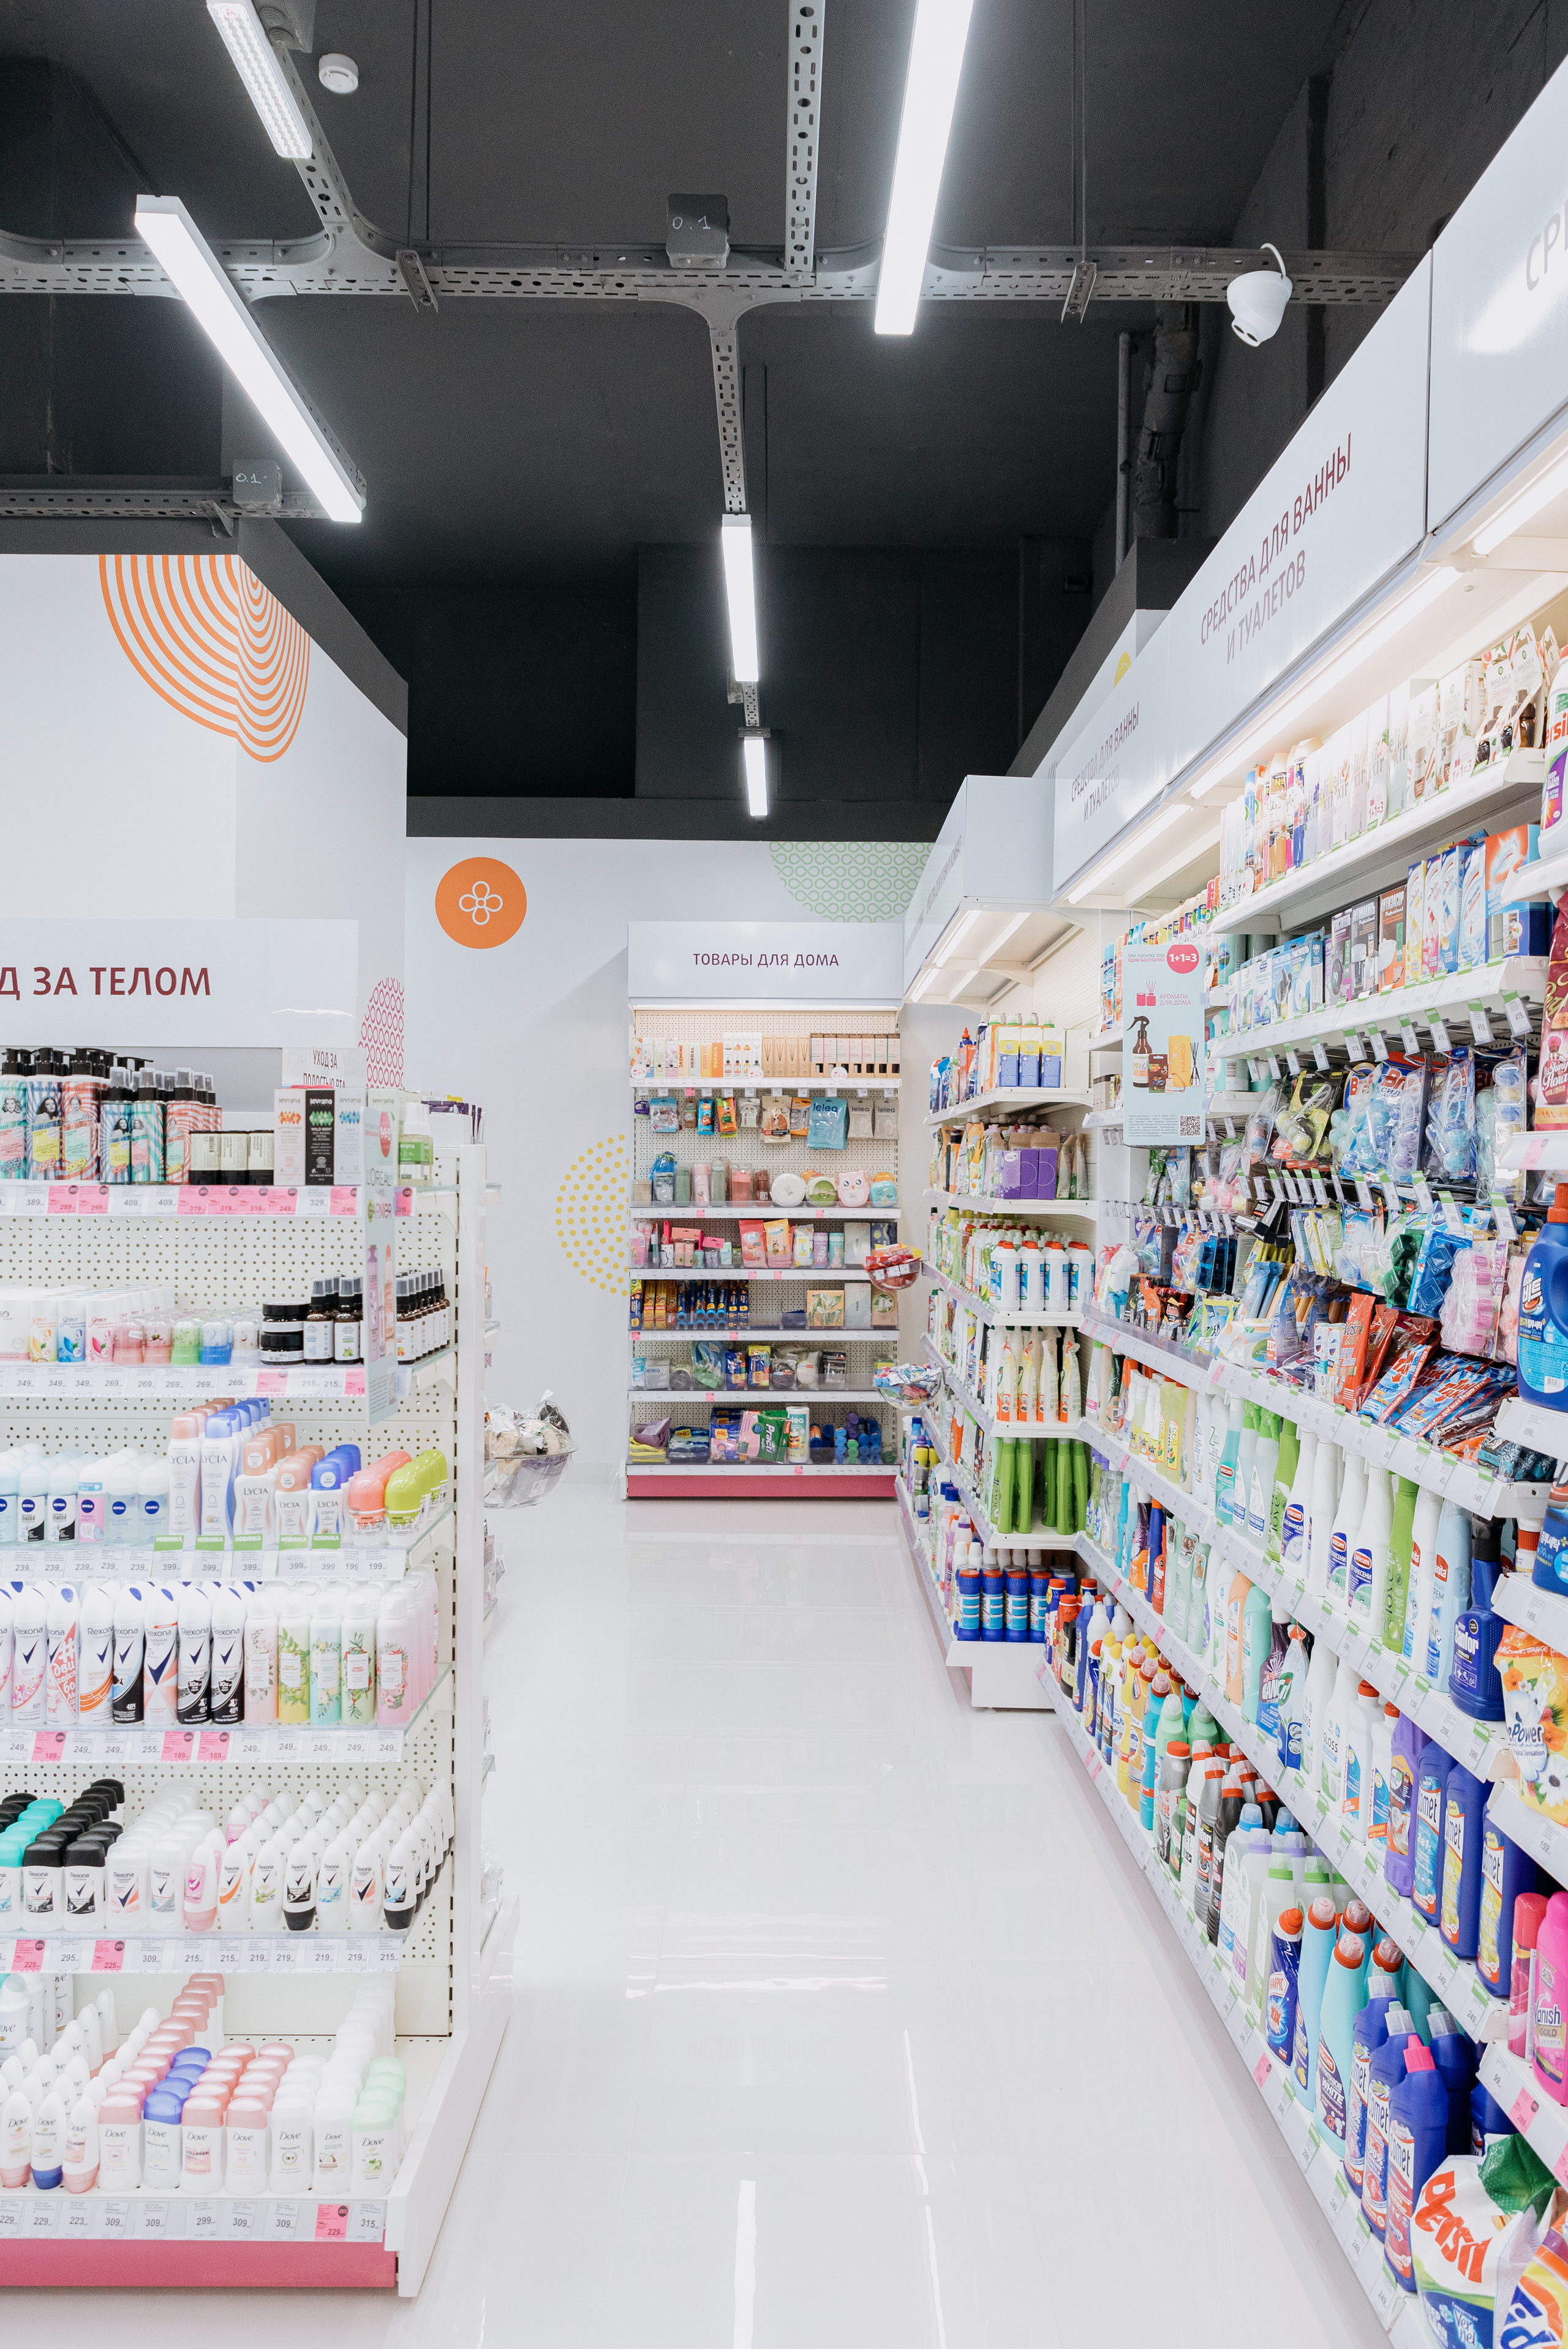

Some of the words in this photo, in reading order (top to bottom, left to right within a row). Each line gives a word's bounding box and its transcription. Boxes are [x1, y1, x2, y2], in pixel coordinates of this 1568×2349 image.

[1526, 200, 1568, 291] СР
[1200, 555, 1255, 645] СРЕДСТВА
[1259, 511, 1288, 584] ДЛЯ
[1294, 433, 1351, 535] ВАННЫ
[1227, 631, 1234, 665] И
[1238, 550, 1305, 651] ТУАЛЕТОВ
[1072, 754, 1098, 802] СРЕДСТВА
[1099, 734, 1112, 774] ДЛЯ
[1115, 701, 1139, 752] ВАННЫ
[1452, 759, 1472, 782] 1+1=3
[1084, 799, 1088, 822] И
[1090, 764, 1120, 816] ТУАЛЕТОВ
[1369, 801, 1384, 820] 1+1=3
[693, 953, 752, 966] ТОВАРЫ
[758, 954, 788, 967] ДЛЯ
[794, 954, 839, 968] ДОМА
[1169, 953, 1197, 962] 1+1=3
[33, 967, 78, 996] ЗА
[89, 967, 211, 996] ТЕЛОМ
[313, 1049, 329, 1070] УХОД
[330, 1053, 337, 1069] ЗА
[1548, 1060, 1568, 1076] Shiny
[1542, 1070, 1568, 1091] Flora
[813, 1103, 838, 1113] lelea
[1523, 1277, 1542, 1303] 비트
[766, 1423, 775, 1454] Practi
[169, 1456, 195, 1464] LYCIA
[202, 1455, 227, 1464] LYCIA
[1287, 1509, 1302, 1520] unicum
[1332, 1538, 1346, 1550] unicum
[1355, 1556, 1370, 1567] unicum
[1526, 1611, 1536, 1621] 189
[15, 1627, 43, 1635] Rexona
[88, 1627, 114, 1635] Rexona
[181, 1627, 209, 1636] Rexona
[1455, 1625, 1479, 1654] Sanfor
[1440, 1725, 1449, 1736] 259
[1323, 1733, 1338, 1753] GLOSS
[1539, 1840, 1550, 1853] 159
[1438, 1973, 1447, 1985] 249
[1539, 2028, 1557, 2037] GOLD
[1493, 2073, 1501, 2084] 99
[1322, 2081, 1344, 2105] WHITE
[8, 2116, 29, 2129] Dove
[37, 2116, 56, 2126] Dove
[1518, 2114, 1526, 2126] 289
[69, 2122, 86, 2132] Dove
[105, 2128, 126, 2138] Dove
[148, 2127, 167, 2137] Dove
[187, 2130, 207, 2141] Dove
[233, 2132, 253, 2141] Dove
[0, 2215, 15, 2224] 229
[1415, 2170, 1493, 2283] Persil
[1351, 2240, 1360, 2253] 249
[1456, 2307, 1472, 2329] Ver
[1460, 2326, 1476, 2345] nel
